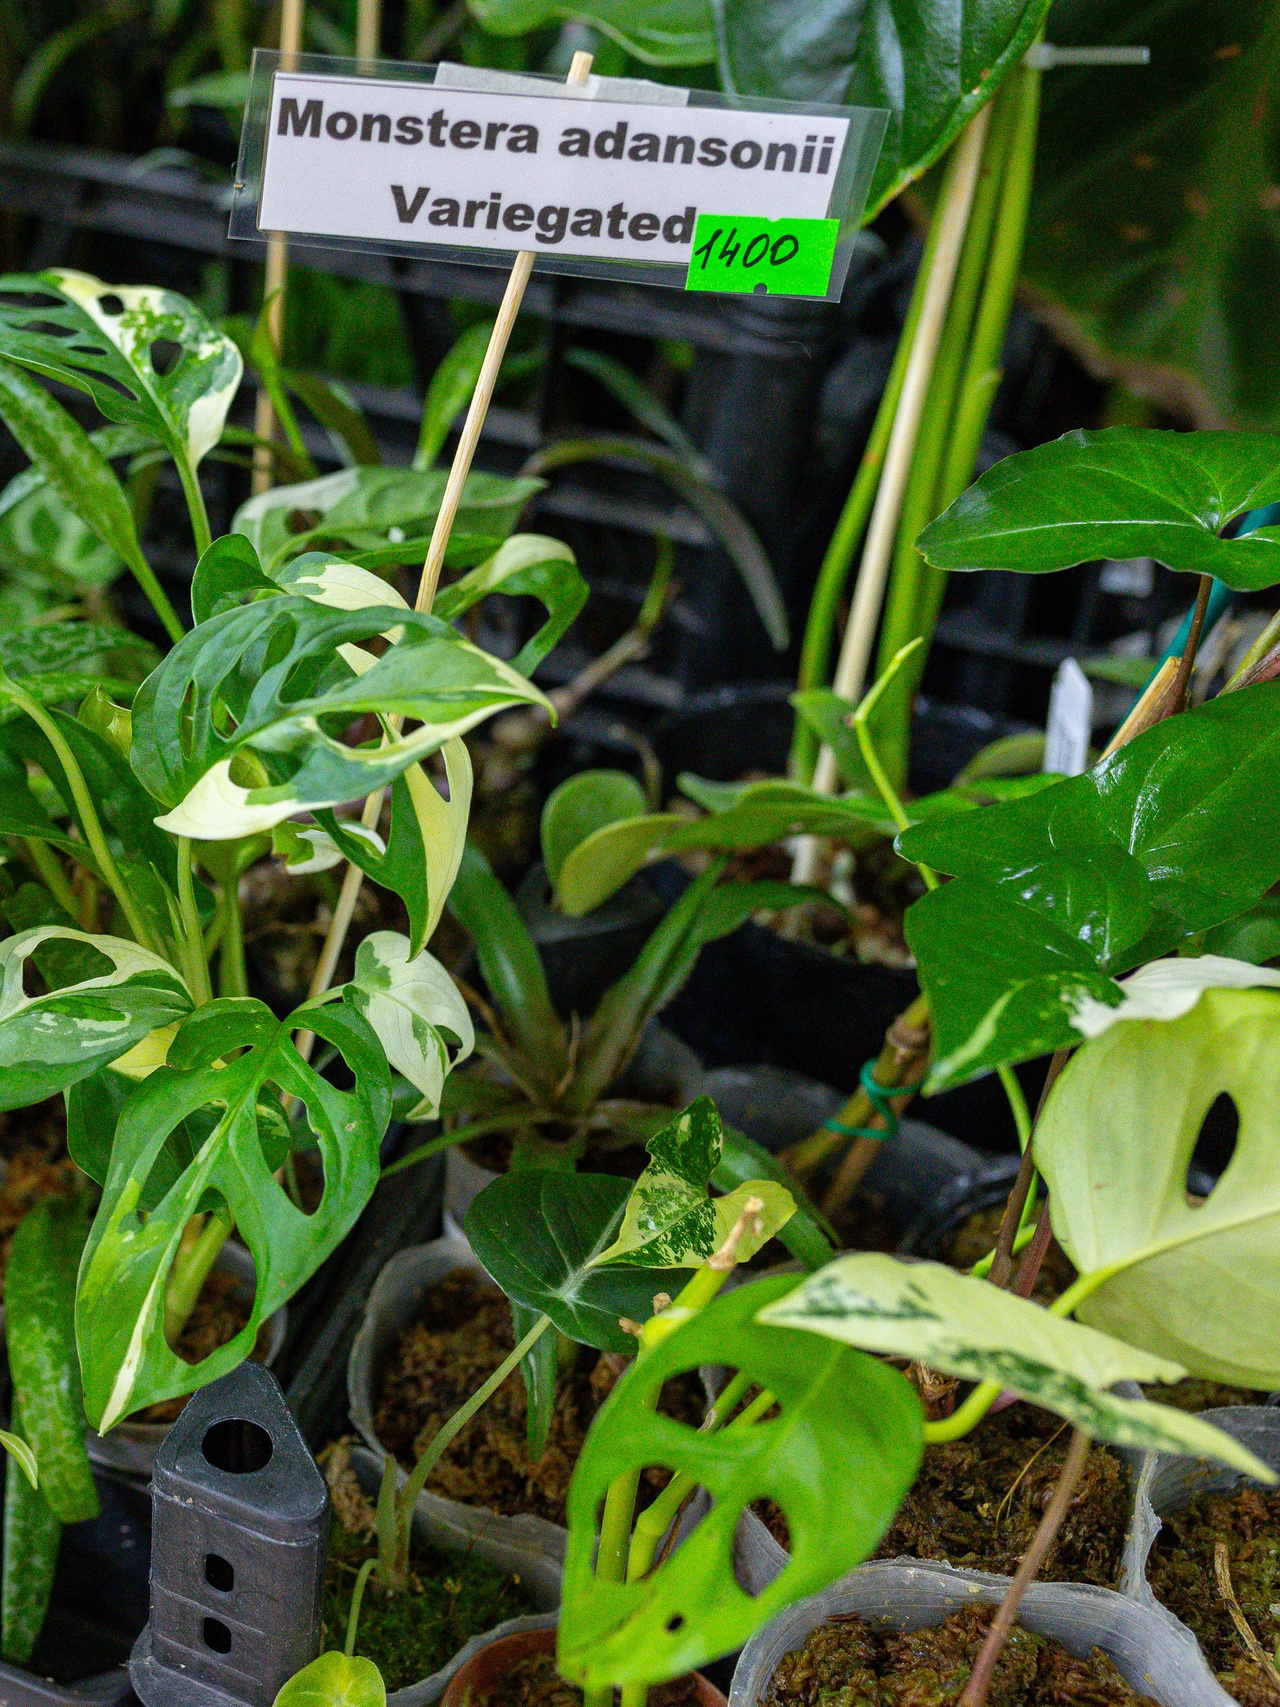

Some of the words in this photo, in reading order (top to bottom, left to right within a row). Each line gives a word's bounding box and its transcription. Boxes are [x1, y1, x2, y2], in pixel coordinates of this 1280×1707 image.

[277, 97, 539, 154] Monstera
[558, 121, 835, 174] adansonii
[390, 184, 697, 245] Variegated
[694, 227, 799, 270] 1400
